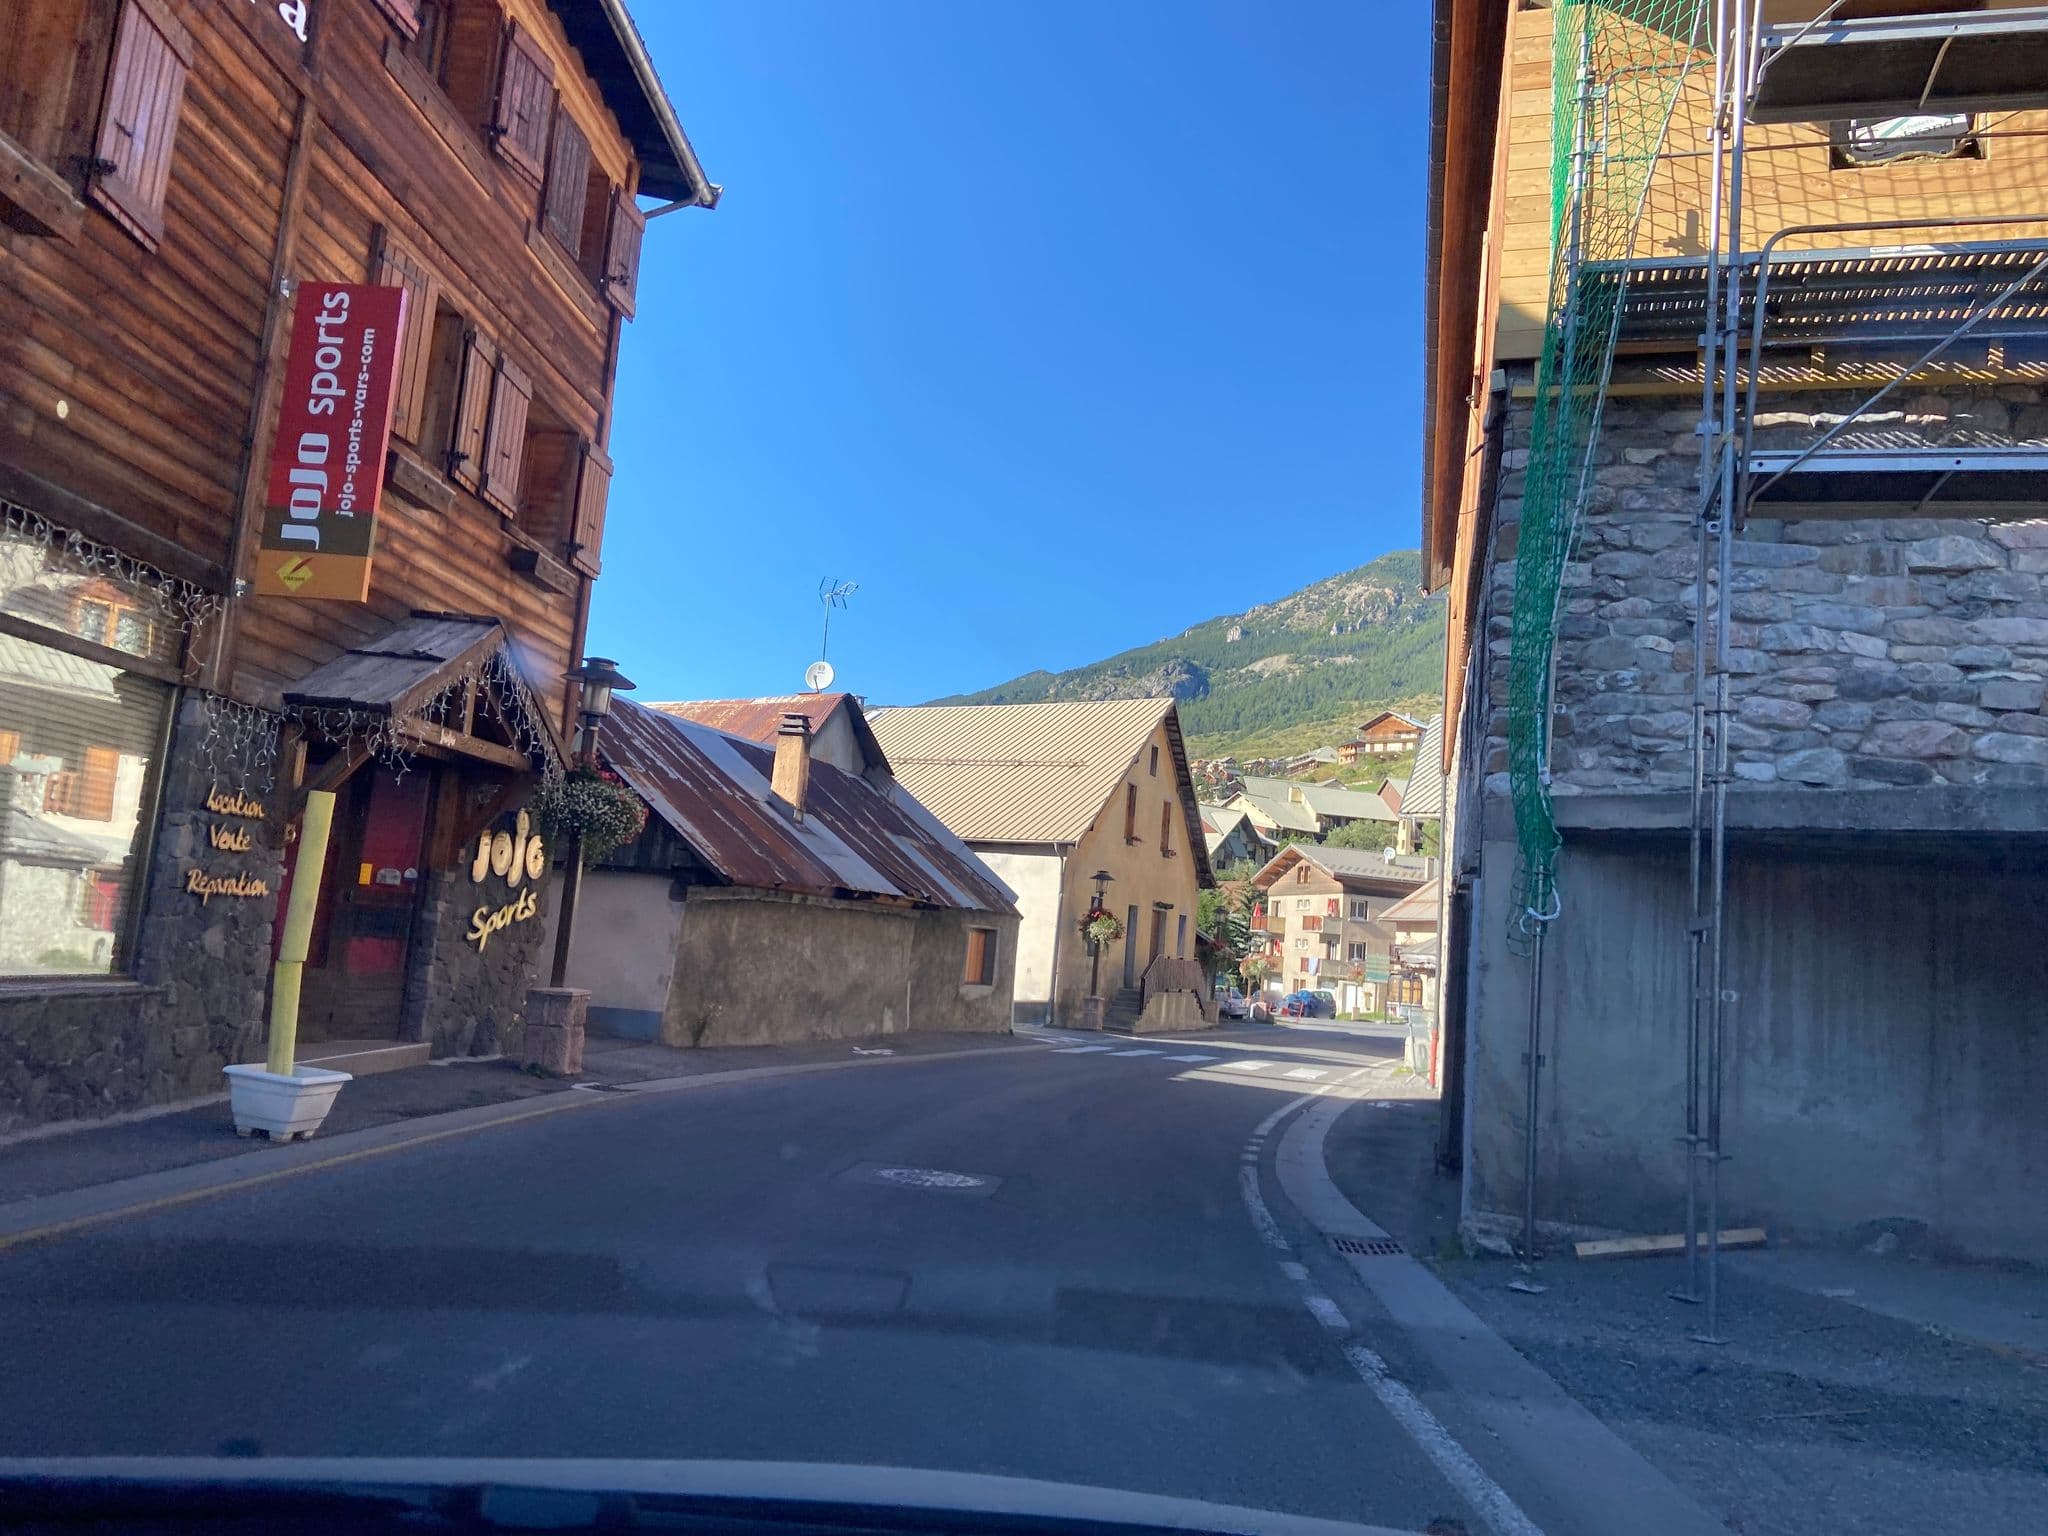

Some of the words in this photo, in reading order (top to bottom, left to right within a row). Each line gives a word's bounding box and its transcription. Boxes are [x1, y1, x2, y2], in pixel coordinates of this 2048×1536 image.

[308, 291, 350, 416] sports
[210, 822, 252, 852] Vente
[466, 886, 537, 953] Sports
